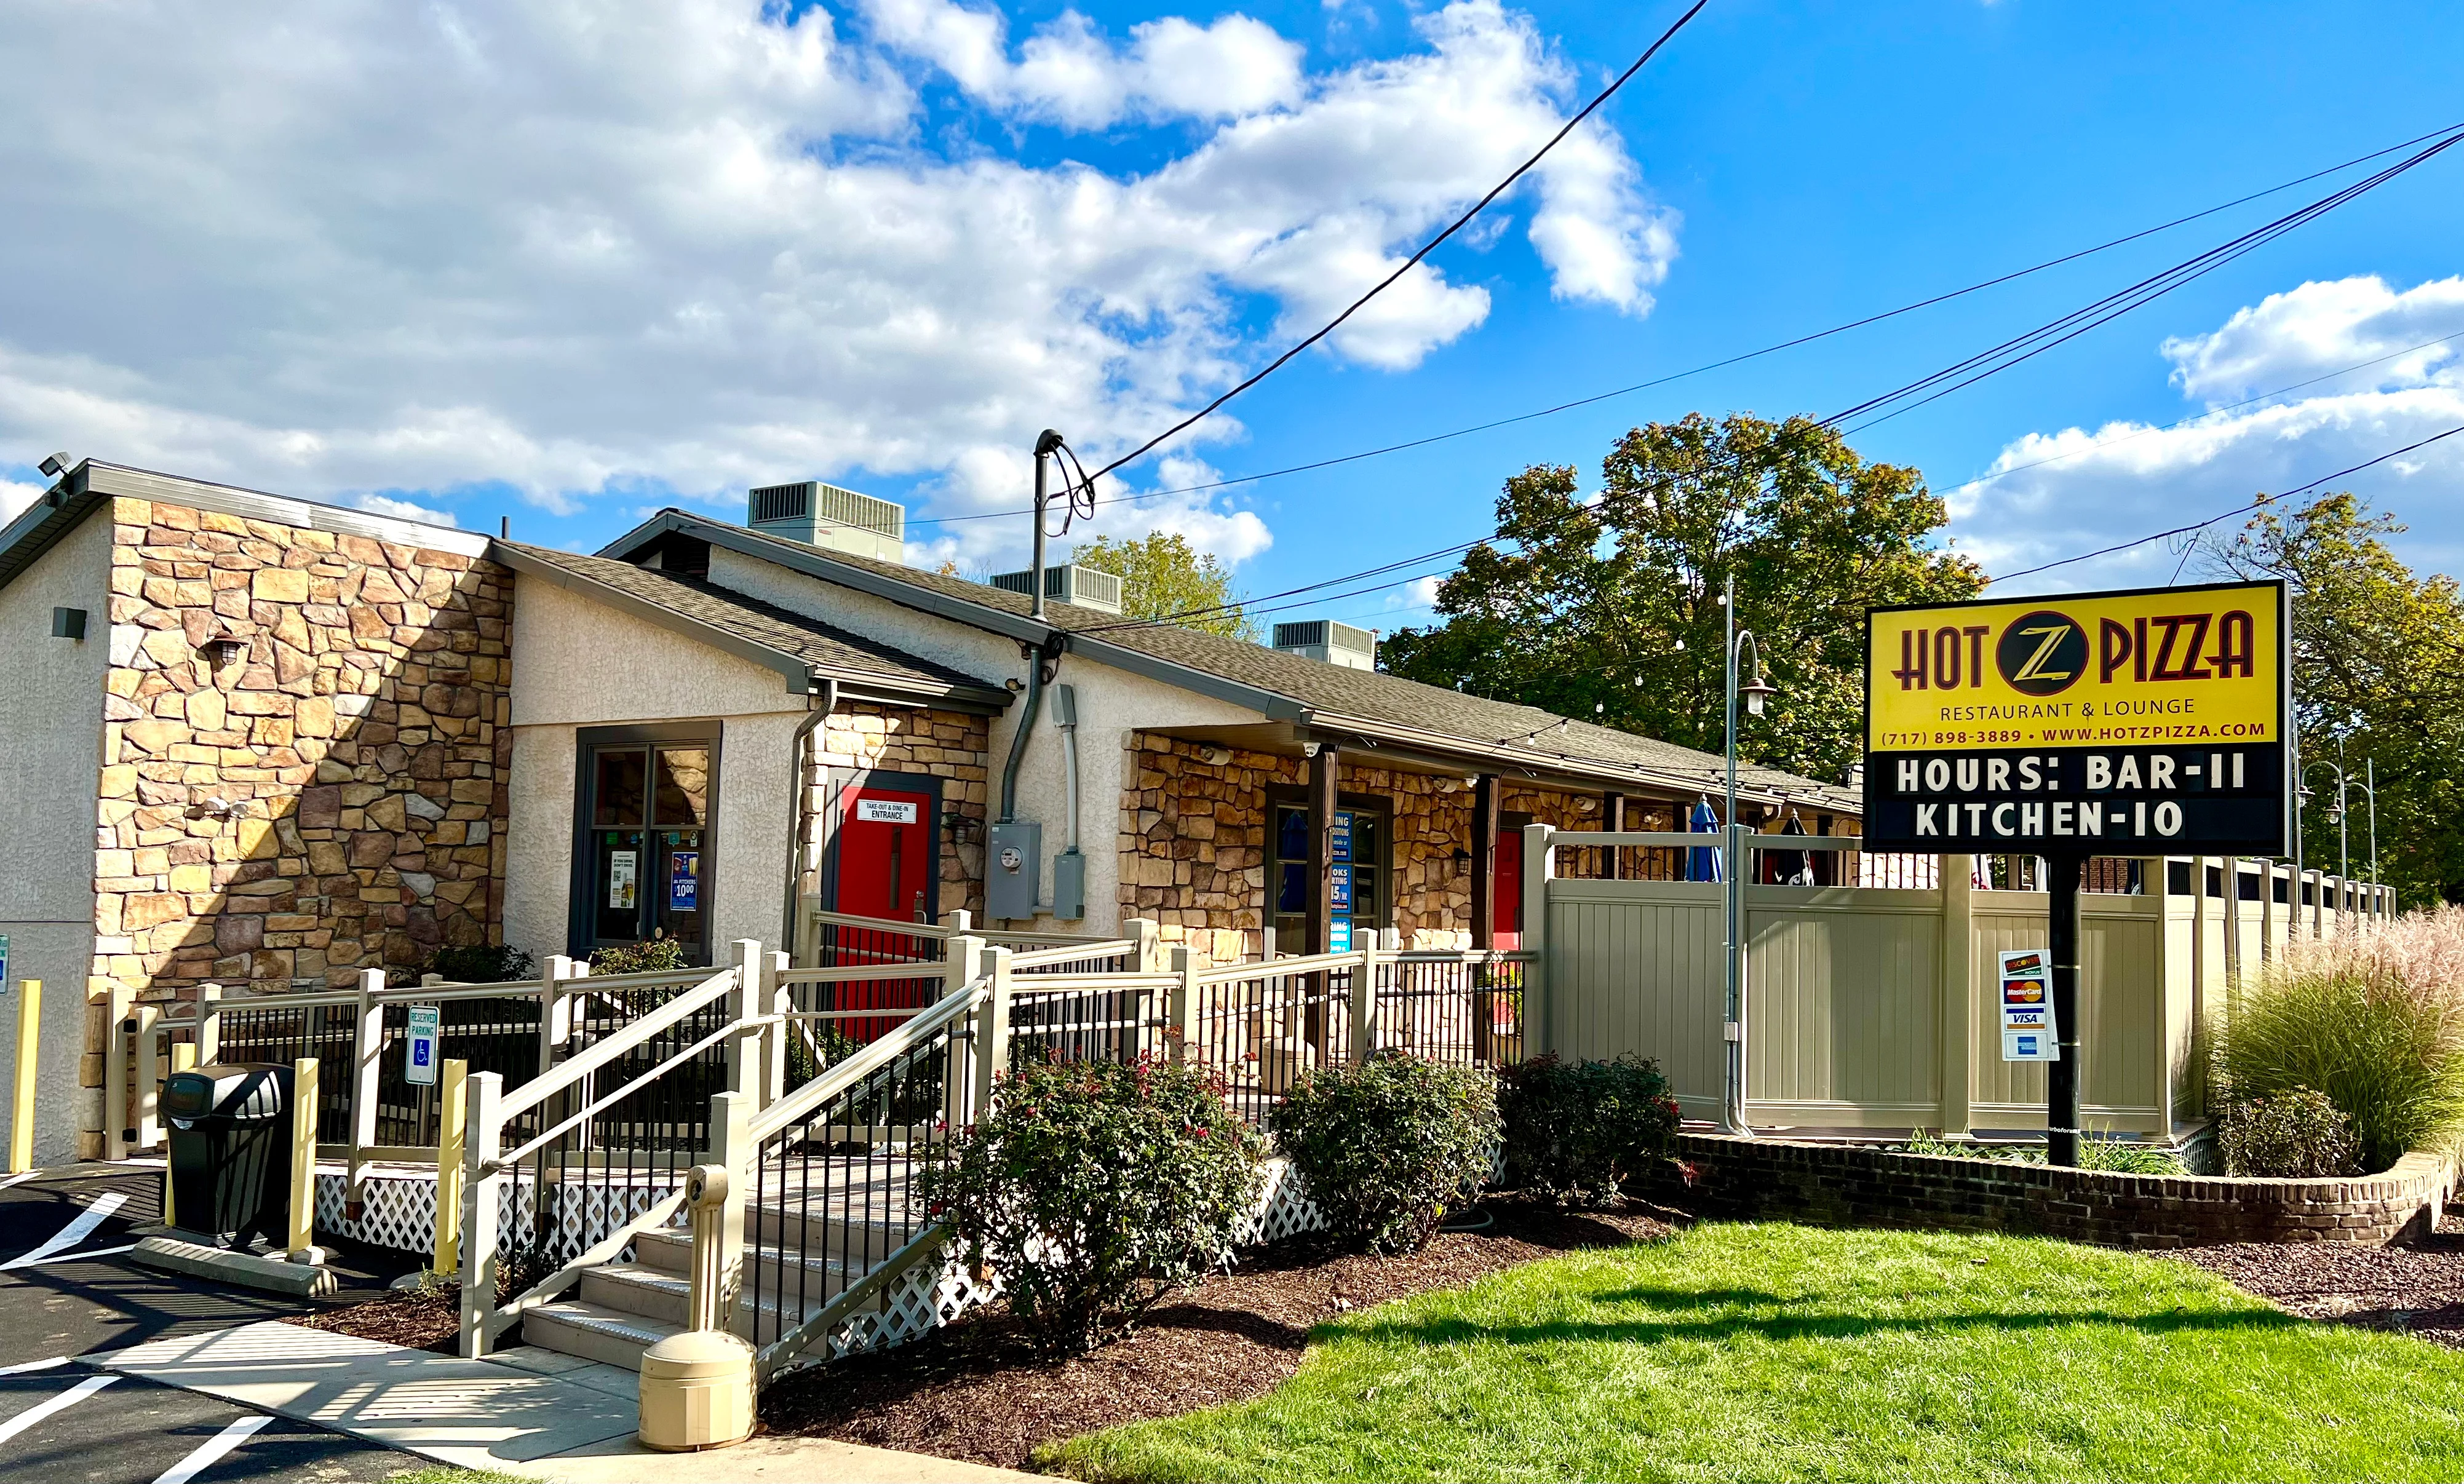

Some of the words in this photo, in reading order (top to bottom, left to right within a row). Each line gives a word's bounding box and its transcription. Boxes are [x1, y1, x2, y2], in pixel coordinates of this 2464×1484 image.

[1891, 625, 1990, 691] HOT
[2013, 624, 2072, 682] Z
[2099, 609, 2254, 684] PIZZA
[1941, 703, 2073, 721] RESTAURANT
[2081, 702, 2094, 716] &
[2104, 698, 2195, 716] LOUNGE
[1882, 731, 1928, 747] (717)
[1934, 729, 2021, 744] 898-3889
[2041, 723, 2265, 741] WWW.HOTZPIZZA.COM
[1898, 756, 2059, 792] HOURS:
[872, 811, 903, 820] ENTRANCE
[1335, 816, 1349, 826] ING
[1330, 921, 1347, 932] RING
[2006, 956, 2040, 969] DISCOVER
[411, 1012, 437, 1023] RESERVED
[2013, 1014, 2037, 1023] VISA
[411, 1025, 434, 1036] PARKING
